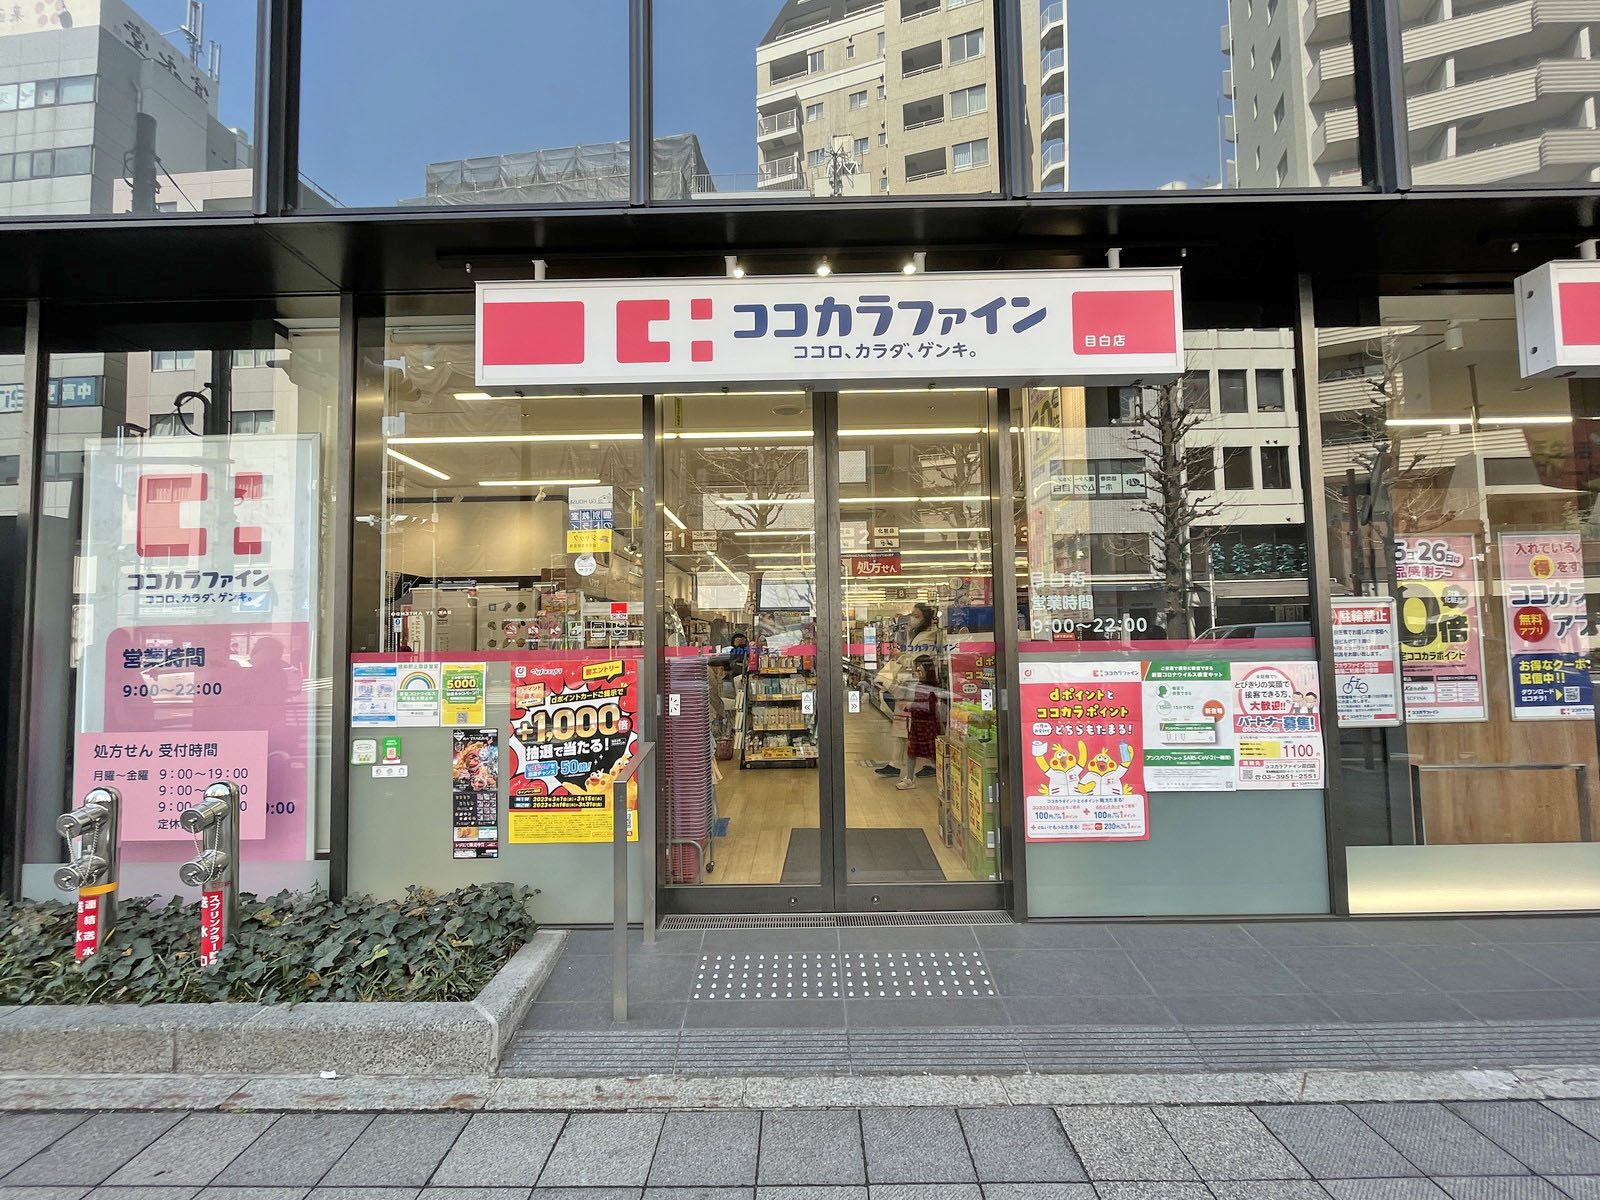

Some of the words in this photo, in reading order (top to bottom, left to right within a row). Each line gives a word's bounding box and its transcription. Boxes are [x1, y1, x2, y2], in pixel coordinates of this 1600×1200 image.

[733, 295, 1047, 339] ココカラファイン
[1085, 333, 1126, 348] 目白店
[793, 342, 977, 360] ココロ、カラダ、ゲンキ。
[857, 560, 898, 574] 処方せん
[127, 569, 270, 591] ココカラファイン
[1030, 570, 1086, 588] 目白店
[1031, 594, 1094, 610] 営業時間
[1032, 617, 1148, 633] 9:00～22:00
[1518, 613, 1543, 626] 無料
[1519, 626, 1544, 636] アプリ
[122, 647, 206, 669] 営業時間
[122, 681, 222, 697] 9:00～22:00
[1234, 680, 1290, 689] とびきりの笑顔で
[1049, 687, 1115, 701] dポイントと
[1245, 690, 1291, 699] 接客できる方、
[1037, 704, 1129, 719] ココカラポイント
[1250, 701, 1286, 711] 大歓迎!!
[1055, 723, 1133, 736] どちらもたまる!
[1238, 716, 1315, 731] パートナー募集!
[93, 744, 154, 759] 処方せん
[158, 743, 218, 758] 受付時間
[526, 737, 609, 761] 抽選で当たる!
[1283, 744, 1314, 758] 1100
[93, 770, 149, 782] 月曜～金曜
[157, 819, 184, 830] 定休
